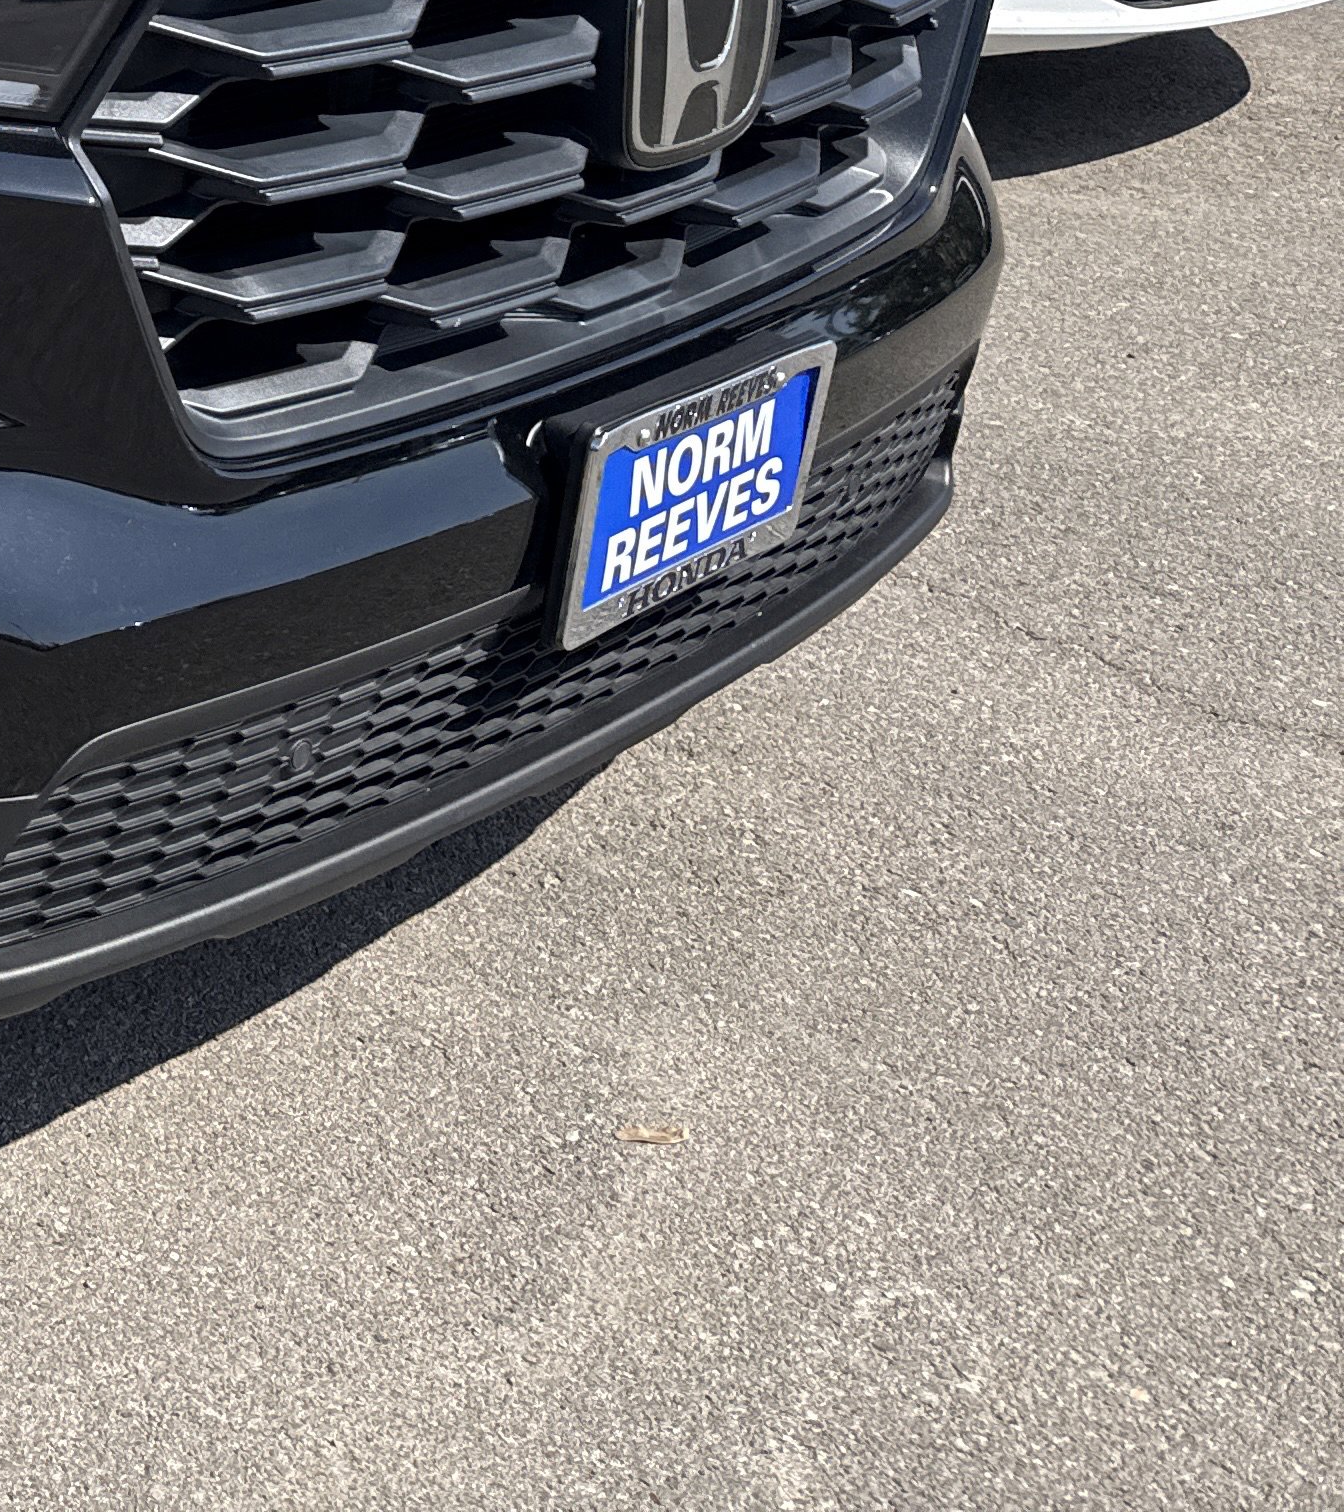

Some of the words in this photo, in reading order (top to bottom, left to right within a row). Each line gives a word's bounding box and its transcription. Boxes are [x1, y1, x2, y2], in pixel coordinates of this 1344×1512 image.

[654, 393, 714, 442] NORM
[715, 366, 778, 416] REEVES
[629, 398, 776, 518] NORM
[600, 456, 783, 594] REEVES
[623, 537, 748, 618] HONDA
